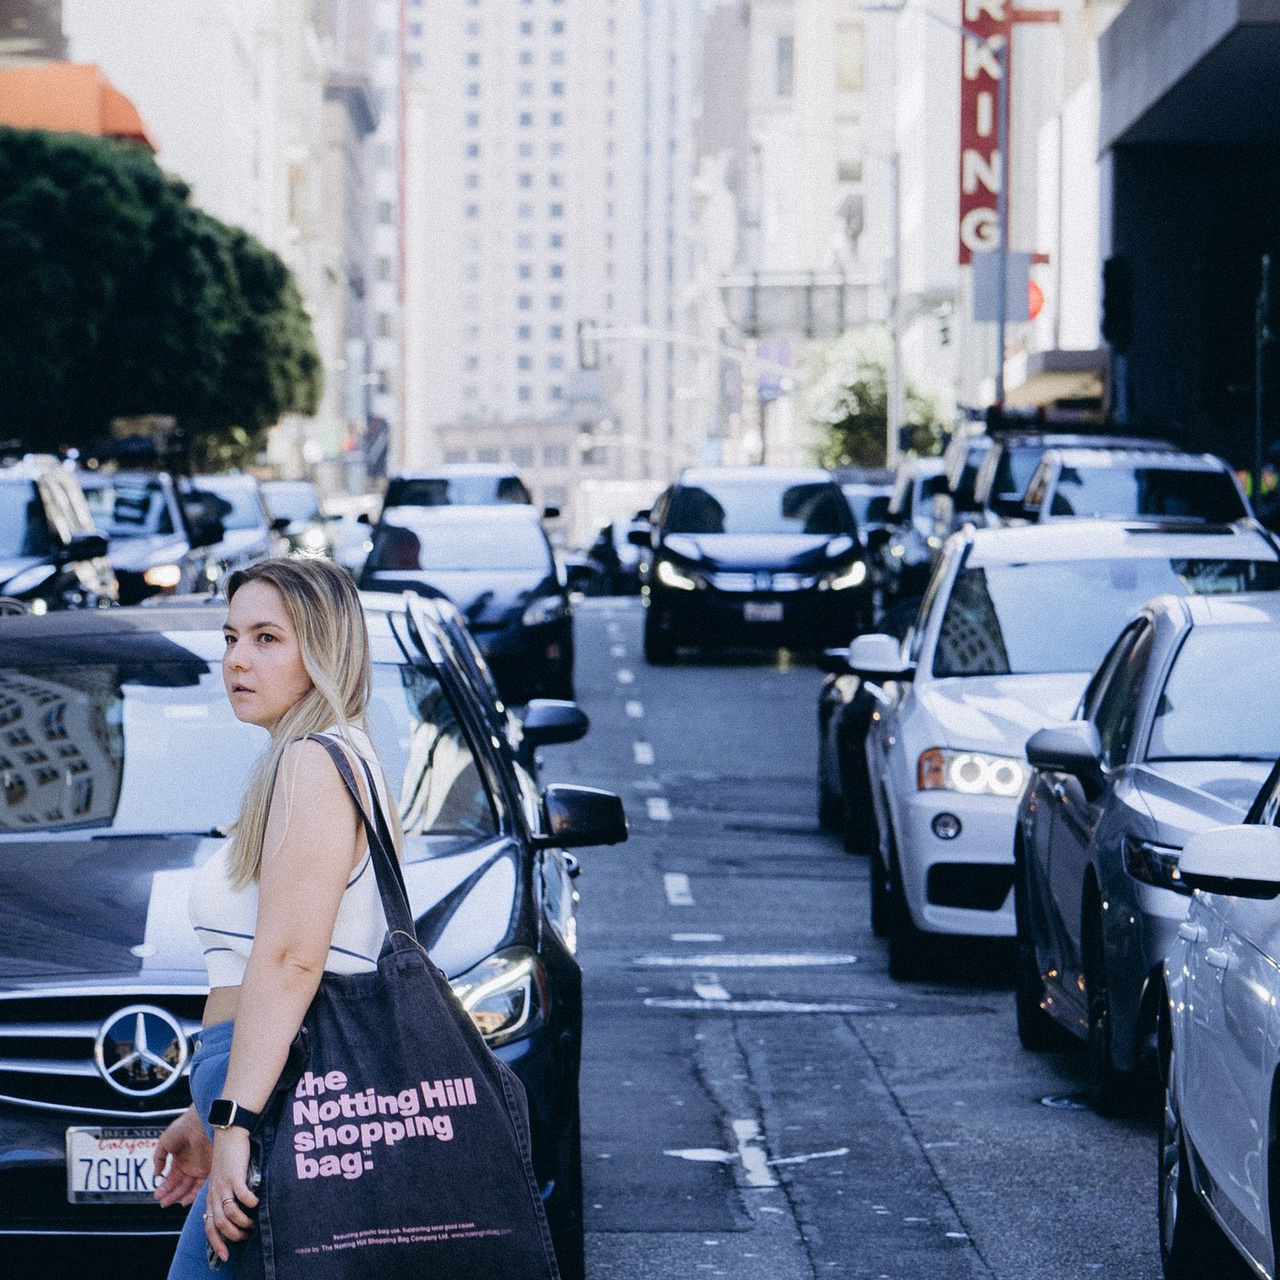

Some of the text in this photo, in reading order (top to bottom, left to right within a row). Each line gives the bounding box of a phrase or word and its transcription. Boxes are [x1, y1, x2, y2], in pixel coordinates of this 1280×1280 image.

[295, 1070, 348, 1098] the
[292, 1077, 477, 1126] Notting Hill
[104, 1129, 161, 1138] BELMO
[293, 1114, 454, 1152] shopping
